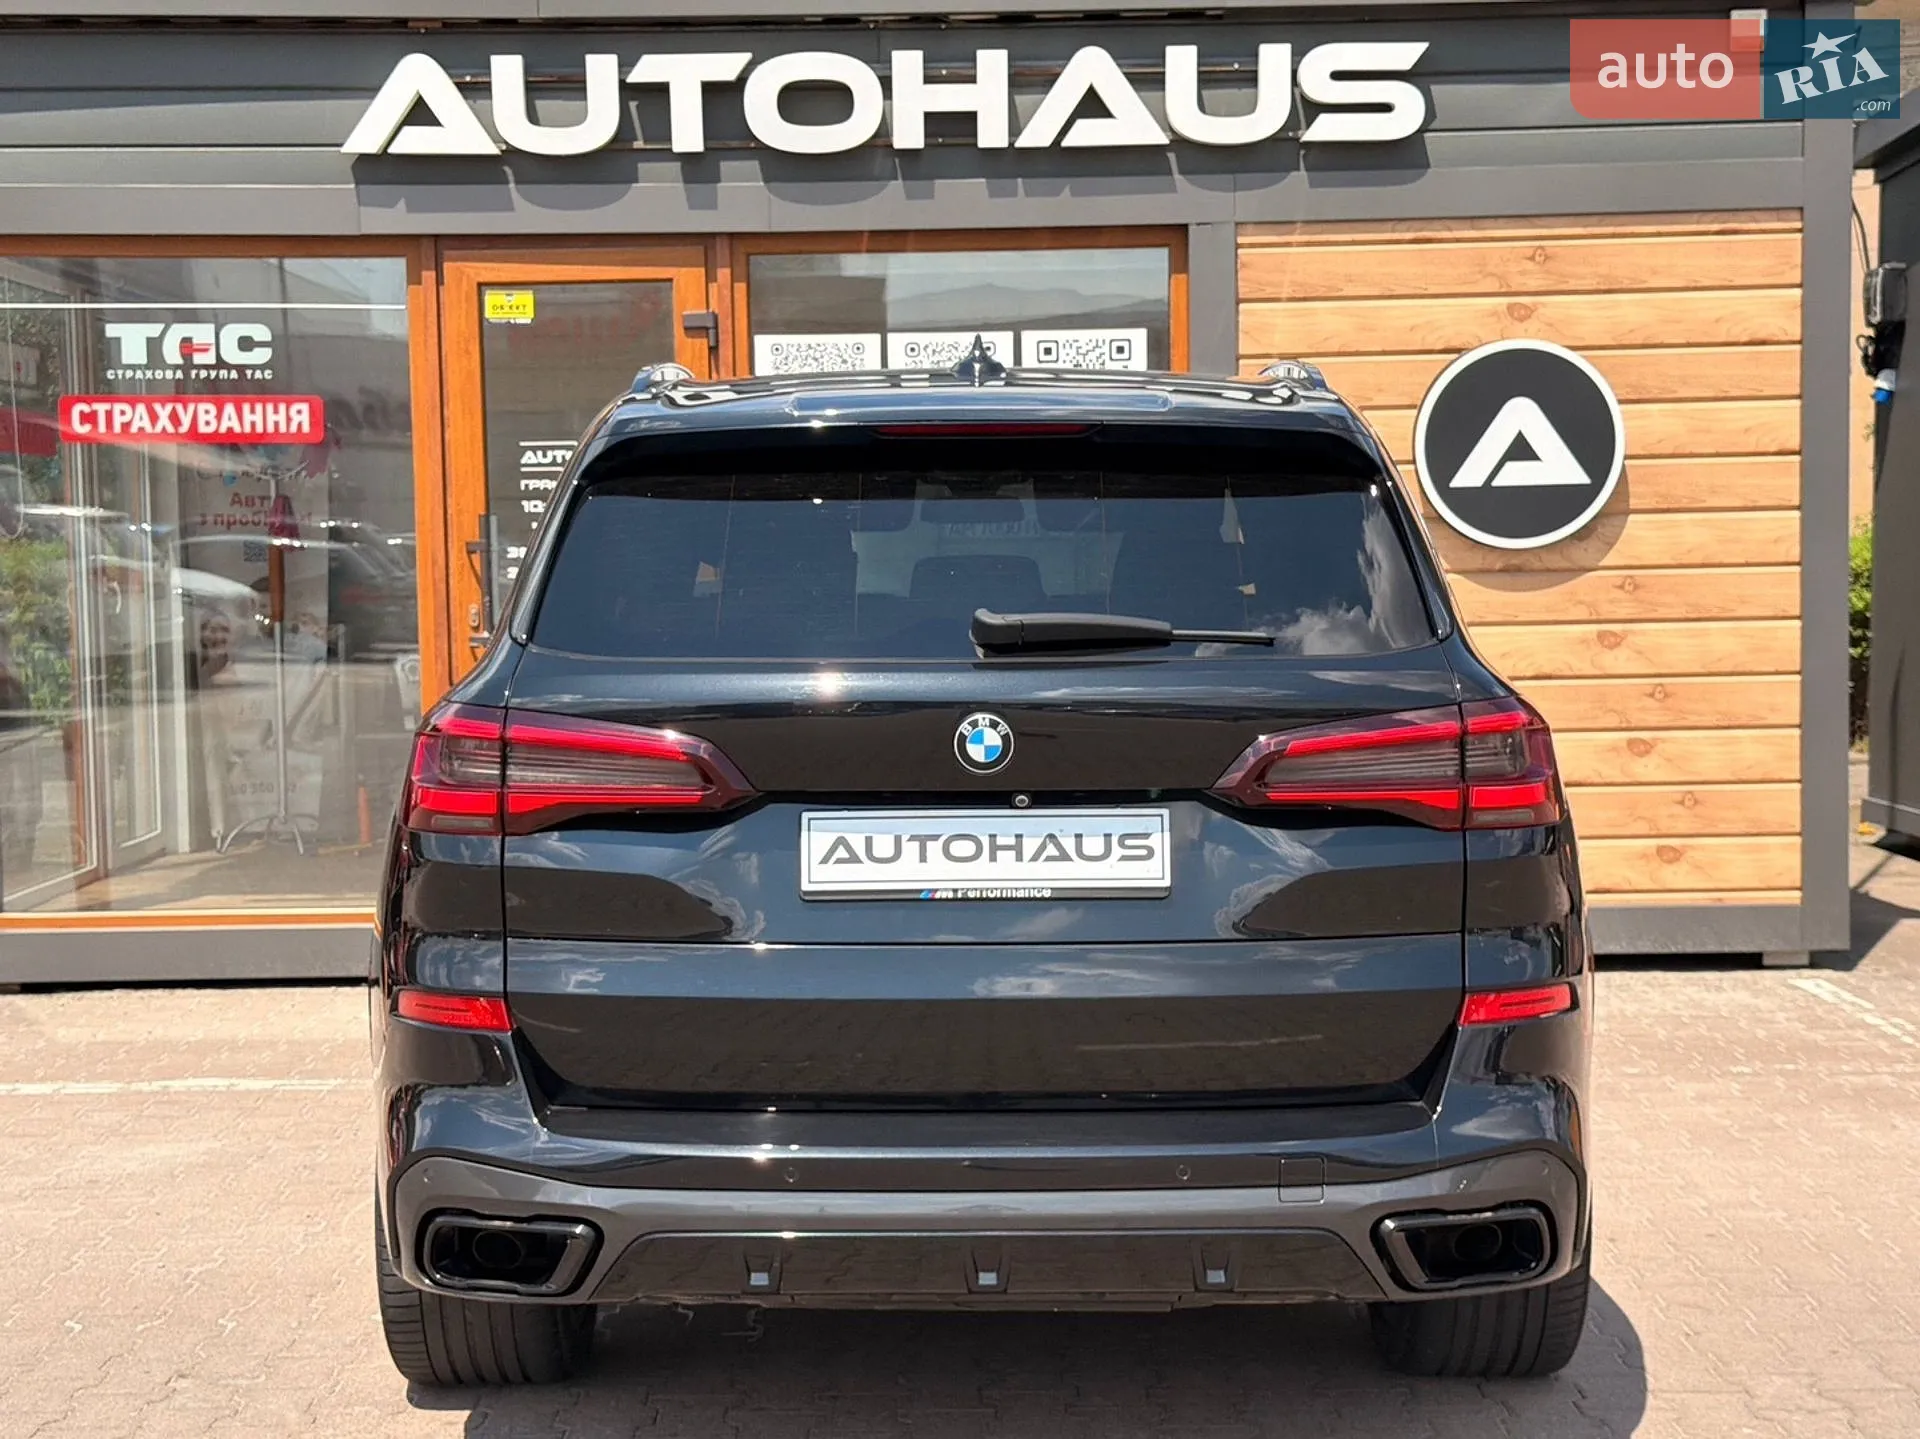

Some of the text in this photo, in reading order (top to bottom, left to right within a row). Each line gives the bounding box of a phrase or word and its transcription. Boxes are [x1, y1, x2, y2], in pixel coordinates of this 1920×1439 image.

[341, 42, 1430, 156] AUTOHAUS
[106, 369, 274, 380] СТРАХОВА ГРУПА ТАС
[71, 402, 310, 434] СТРАХУВАННЯ
[229, 492, 273, 508] Авт
[960, 716, 1009, 736] BMW
[818, 832, 1155, 865] AUTOHAUS
[957, 888, 1052, 898] Performance
